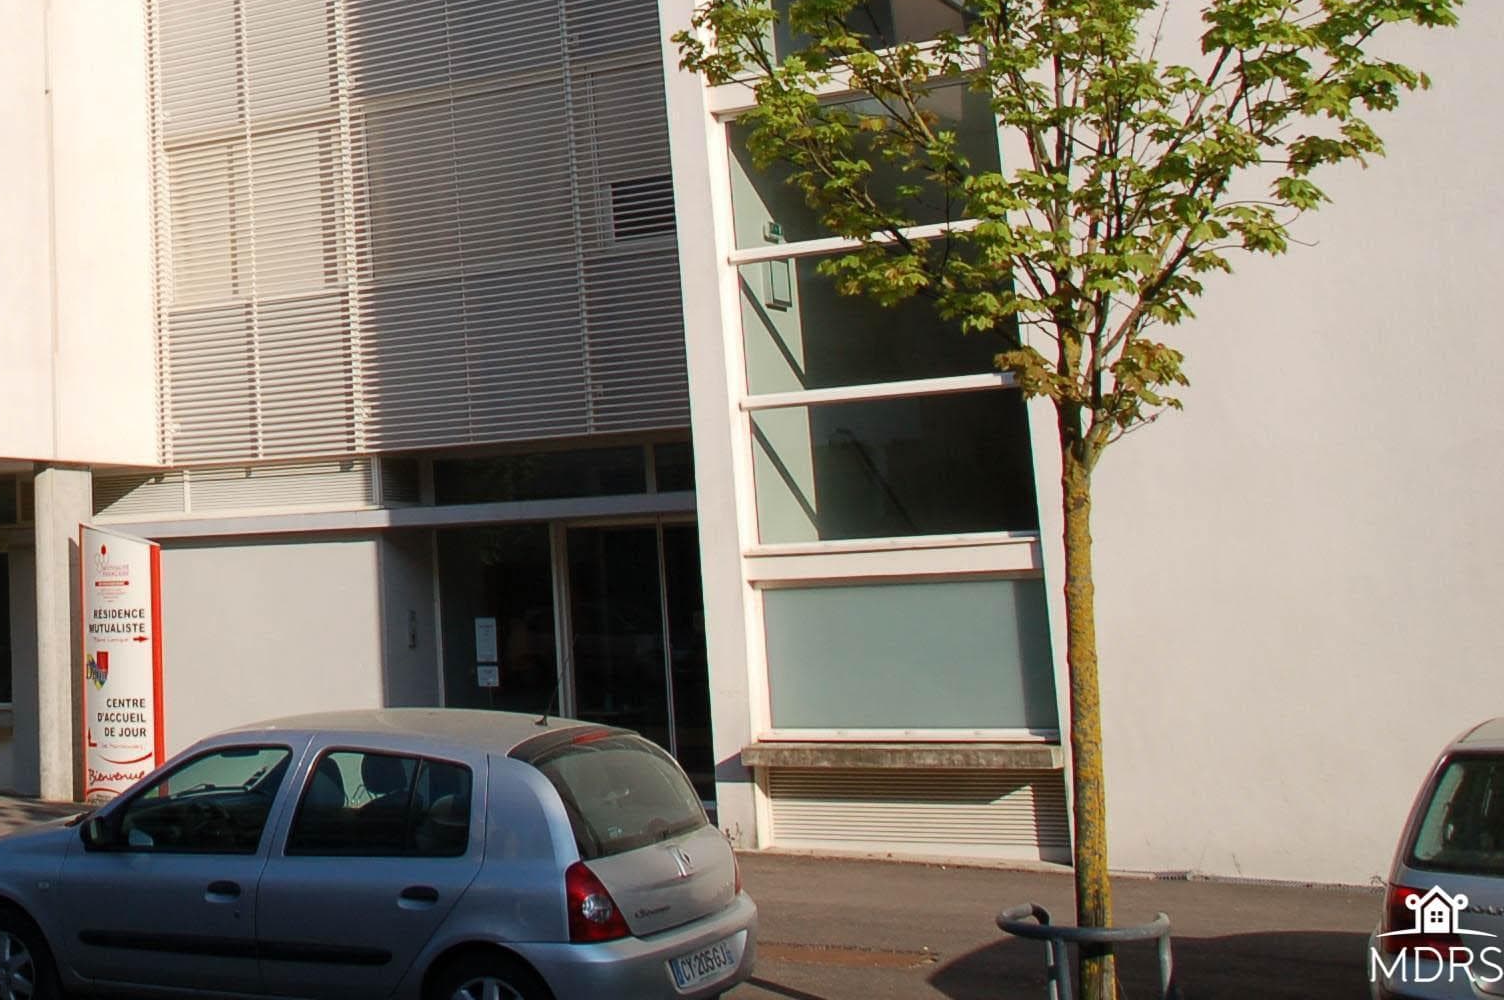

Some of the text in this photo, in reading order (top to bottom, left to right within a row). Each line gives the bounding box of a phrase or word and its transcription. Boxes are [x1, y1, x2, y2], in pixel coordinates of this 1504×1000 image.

[88, 623, 145, 633] MUTUALISTE
[106, 698, 146, 708] CENTRE
[97, 712, 146, 722] D'ACCUEIL
[104, 727, 147, 737] DE JOUR
[88, 768, 145, 786] Bienvenue
